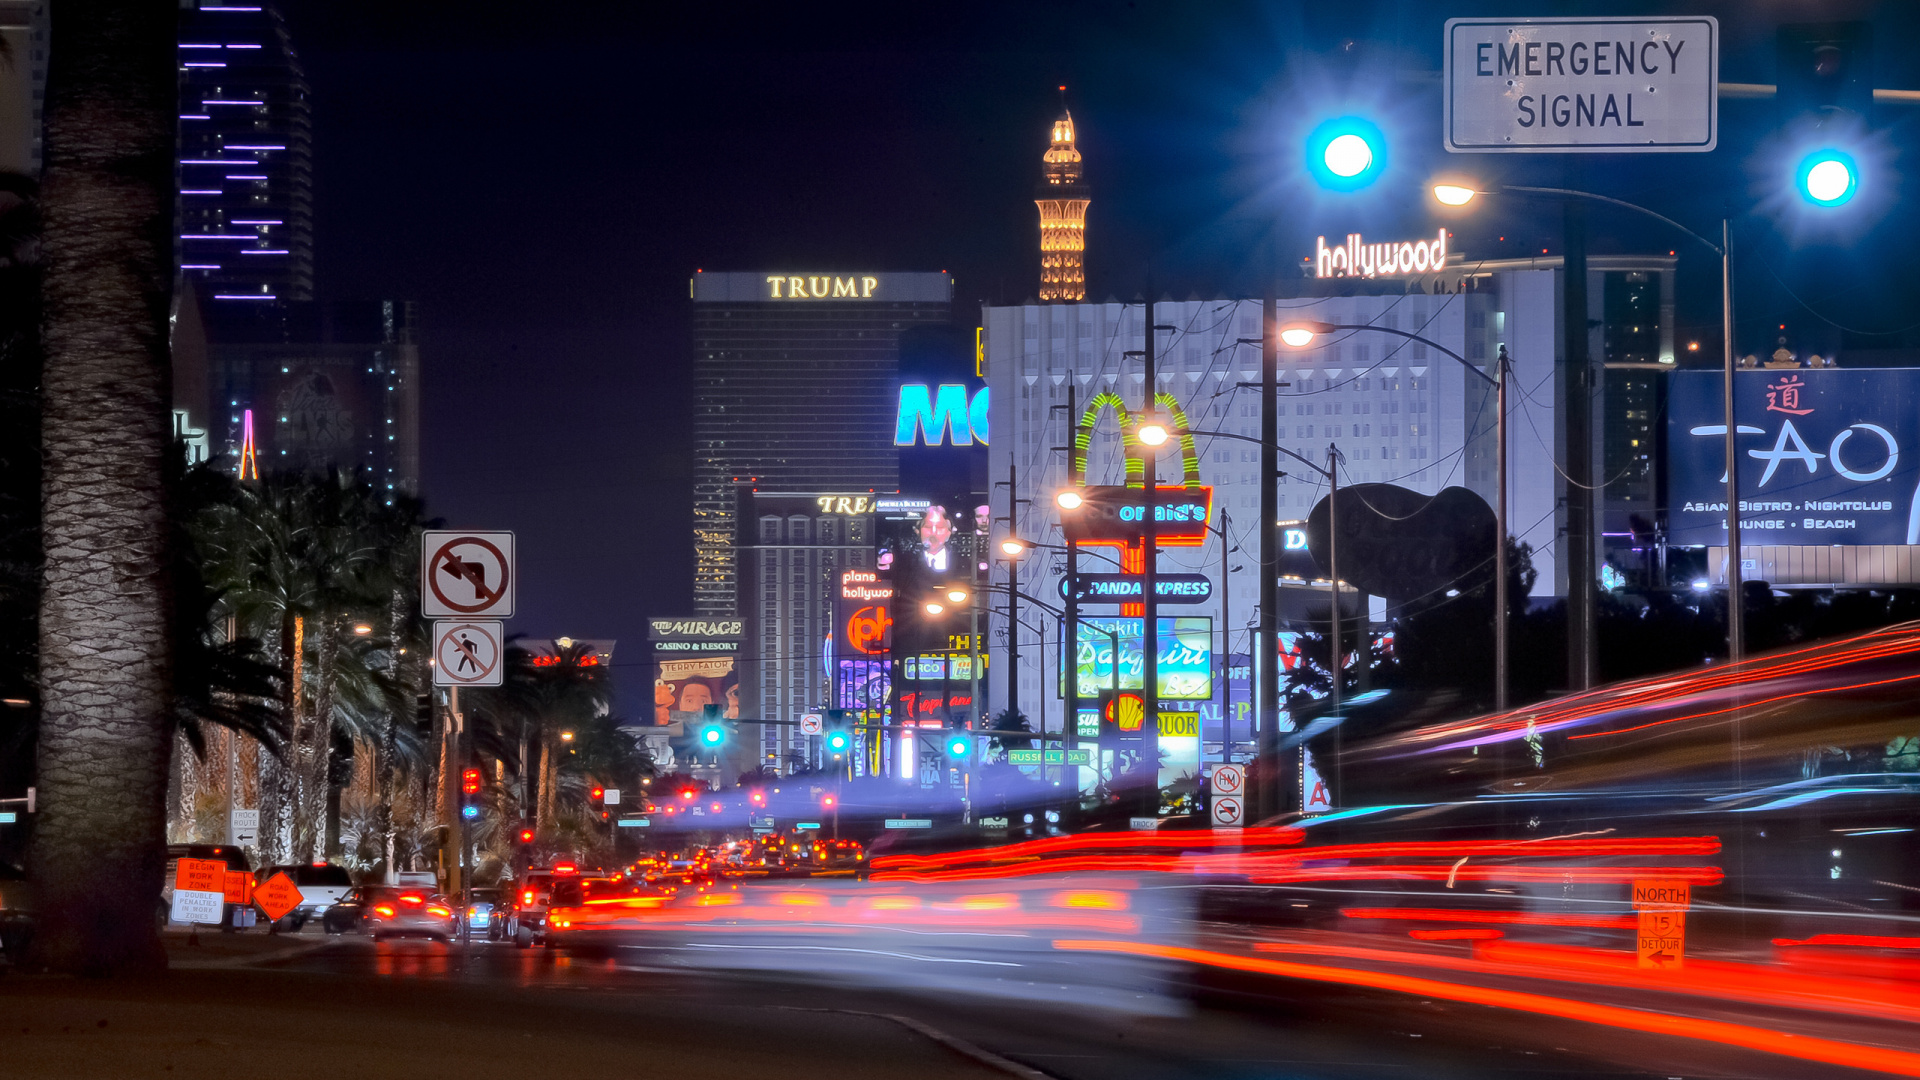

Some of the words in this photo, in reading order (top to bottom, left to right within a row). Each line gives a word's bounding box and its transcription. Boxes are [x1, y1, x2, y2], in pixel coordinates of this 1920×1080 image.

[1477, 40, 1685, 77] EMERGENCY
[1517, 93, 1644, 128] SIGNAL
[1317, 227, 1447, 280] hollywood
[767, 276, 878, 298] TRUMP
[1766, 374, 1815, 416] 道
[1690, 419, 1899, 488] TAO
[1683, 501, 1729, 512] ASIAN
[1739, 501, 1792, 511] BISTRO
[1804, 501, 1893, 511] NIGHTCLUB
[1722, 519, 1785, 529] LUNGE
[1803, 518, 1856, 529] BEACH
[843, 570, 881, 585] plane
[1089, 582, 1142, 595] PANDA
[1155, 582, 1210, 595] XPRESS
[672, 621, 742, 636] MIRAGE
[1083, 620, 1144, 636] Chakit
[655, 642, 690, 650] CASINO
[691, 642, 700, 650] &
[701, 642, 738, 650] RESORT
[665, 663, 696, 672] TERRY
[698, 660, 729, 670] FATOR
[908, 664, 940, 673] ARCO
[1157, 715, 1197, 737] QUOR
[1010, 753, 1056, 761] RUSSELL
[1219, 774, 1236, 785] HM
[234, 811, 257, 819] TRUCK
[189, 862, 215, 871] BEGIN
[189, 872, 213, 880] WORK
[226, 876, 249, 886] SSELL
[189, 881, 212, 889] ZONE
[269, 883, 289, 892] ROAD
[185, 891, 213, 900] DOUBLE
[226, 889, 241, 897] OAD
[1636, 888, 1687, 902] NORTH
[180, 898, 217, 907] PENALTIES
[265, 901, 290, 909] AHEAD
[185, 912, 208, 920] ZONES
[1654, 916, 1670, 930] 15
[1641, 939, 1680, 949] DETOUR
